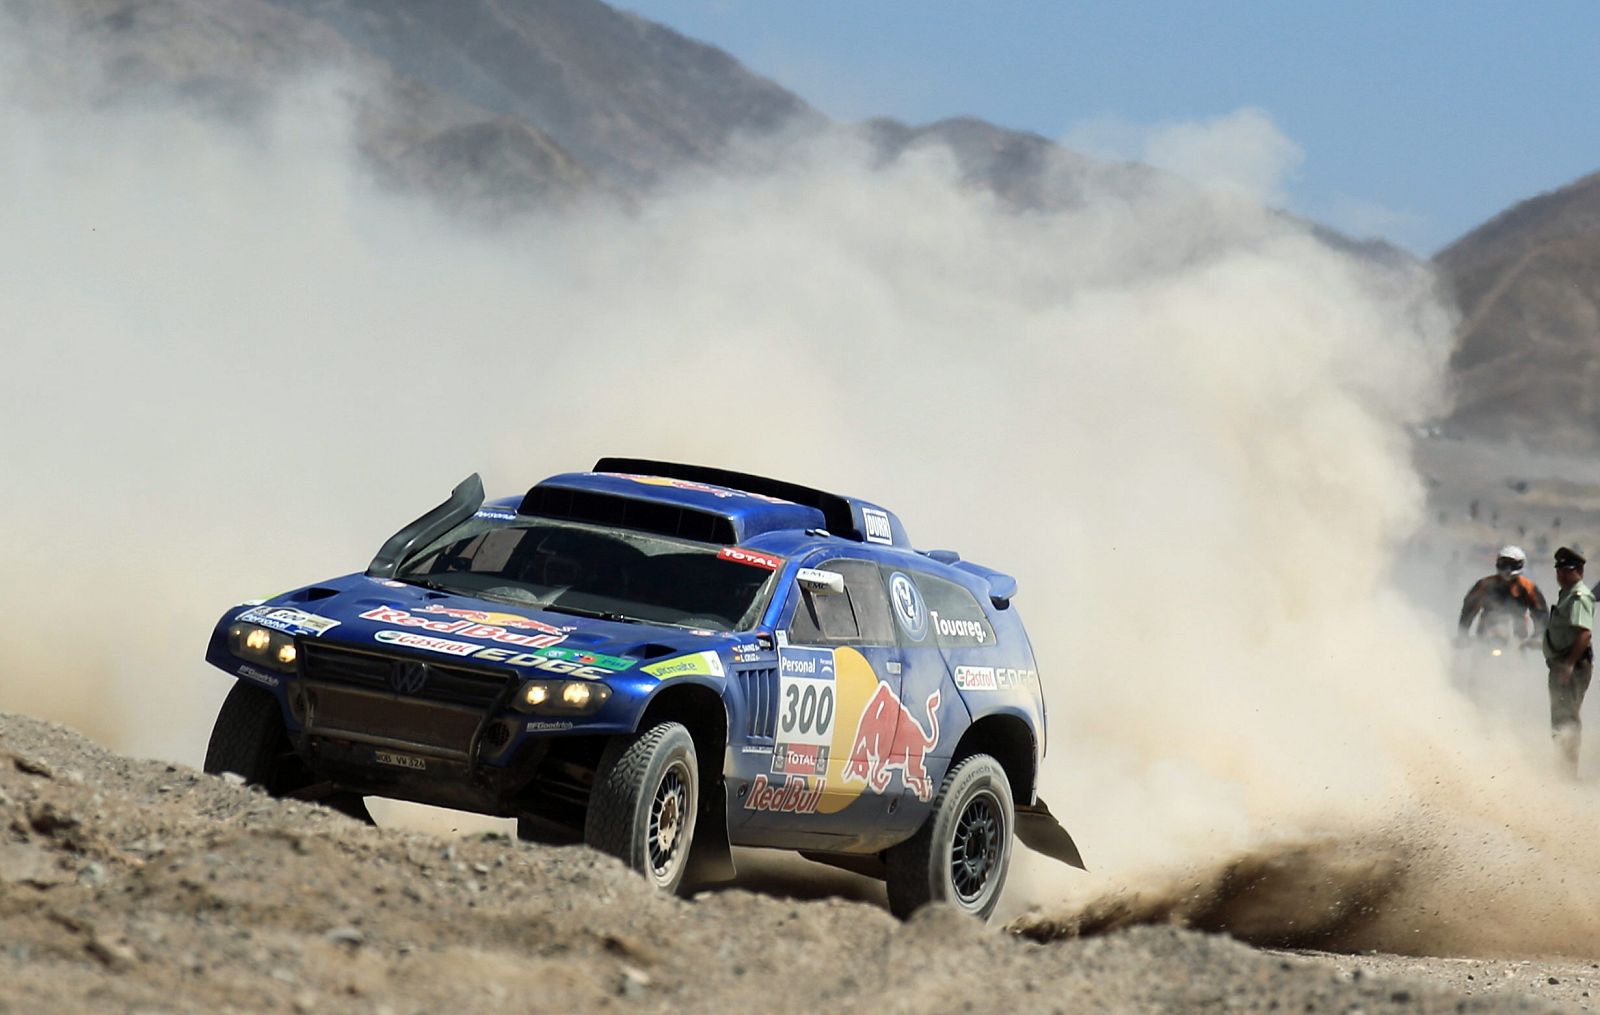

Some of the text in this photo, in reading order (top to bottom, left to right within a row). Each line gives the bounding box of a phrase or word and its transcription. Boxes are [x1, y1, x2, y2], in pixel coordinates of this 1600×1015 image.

[723, 548, 777, 568] TOTAL
[399, 635, 473, 653] Castrol
[472, 648, 615, 680] EDGE
[781, 657, 816, 673] Personal
[965, 670, 993, 687] Castrol
[781, 684, 834, 736] 300
[787, 750, 816, 766] TOTAL
